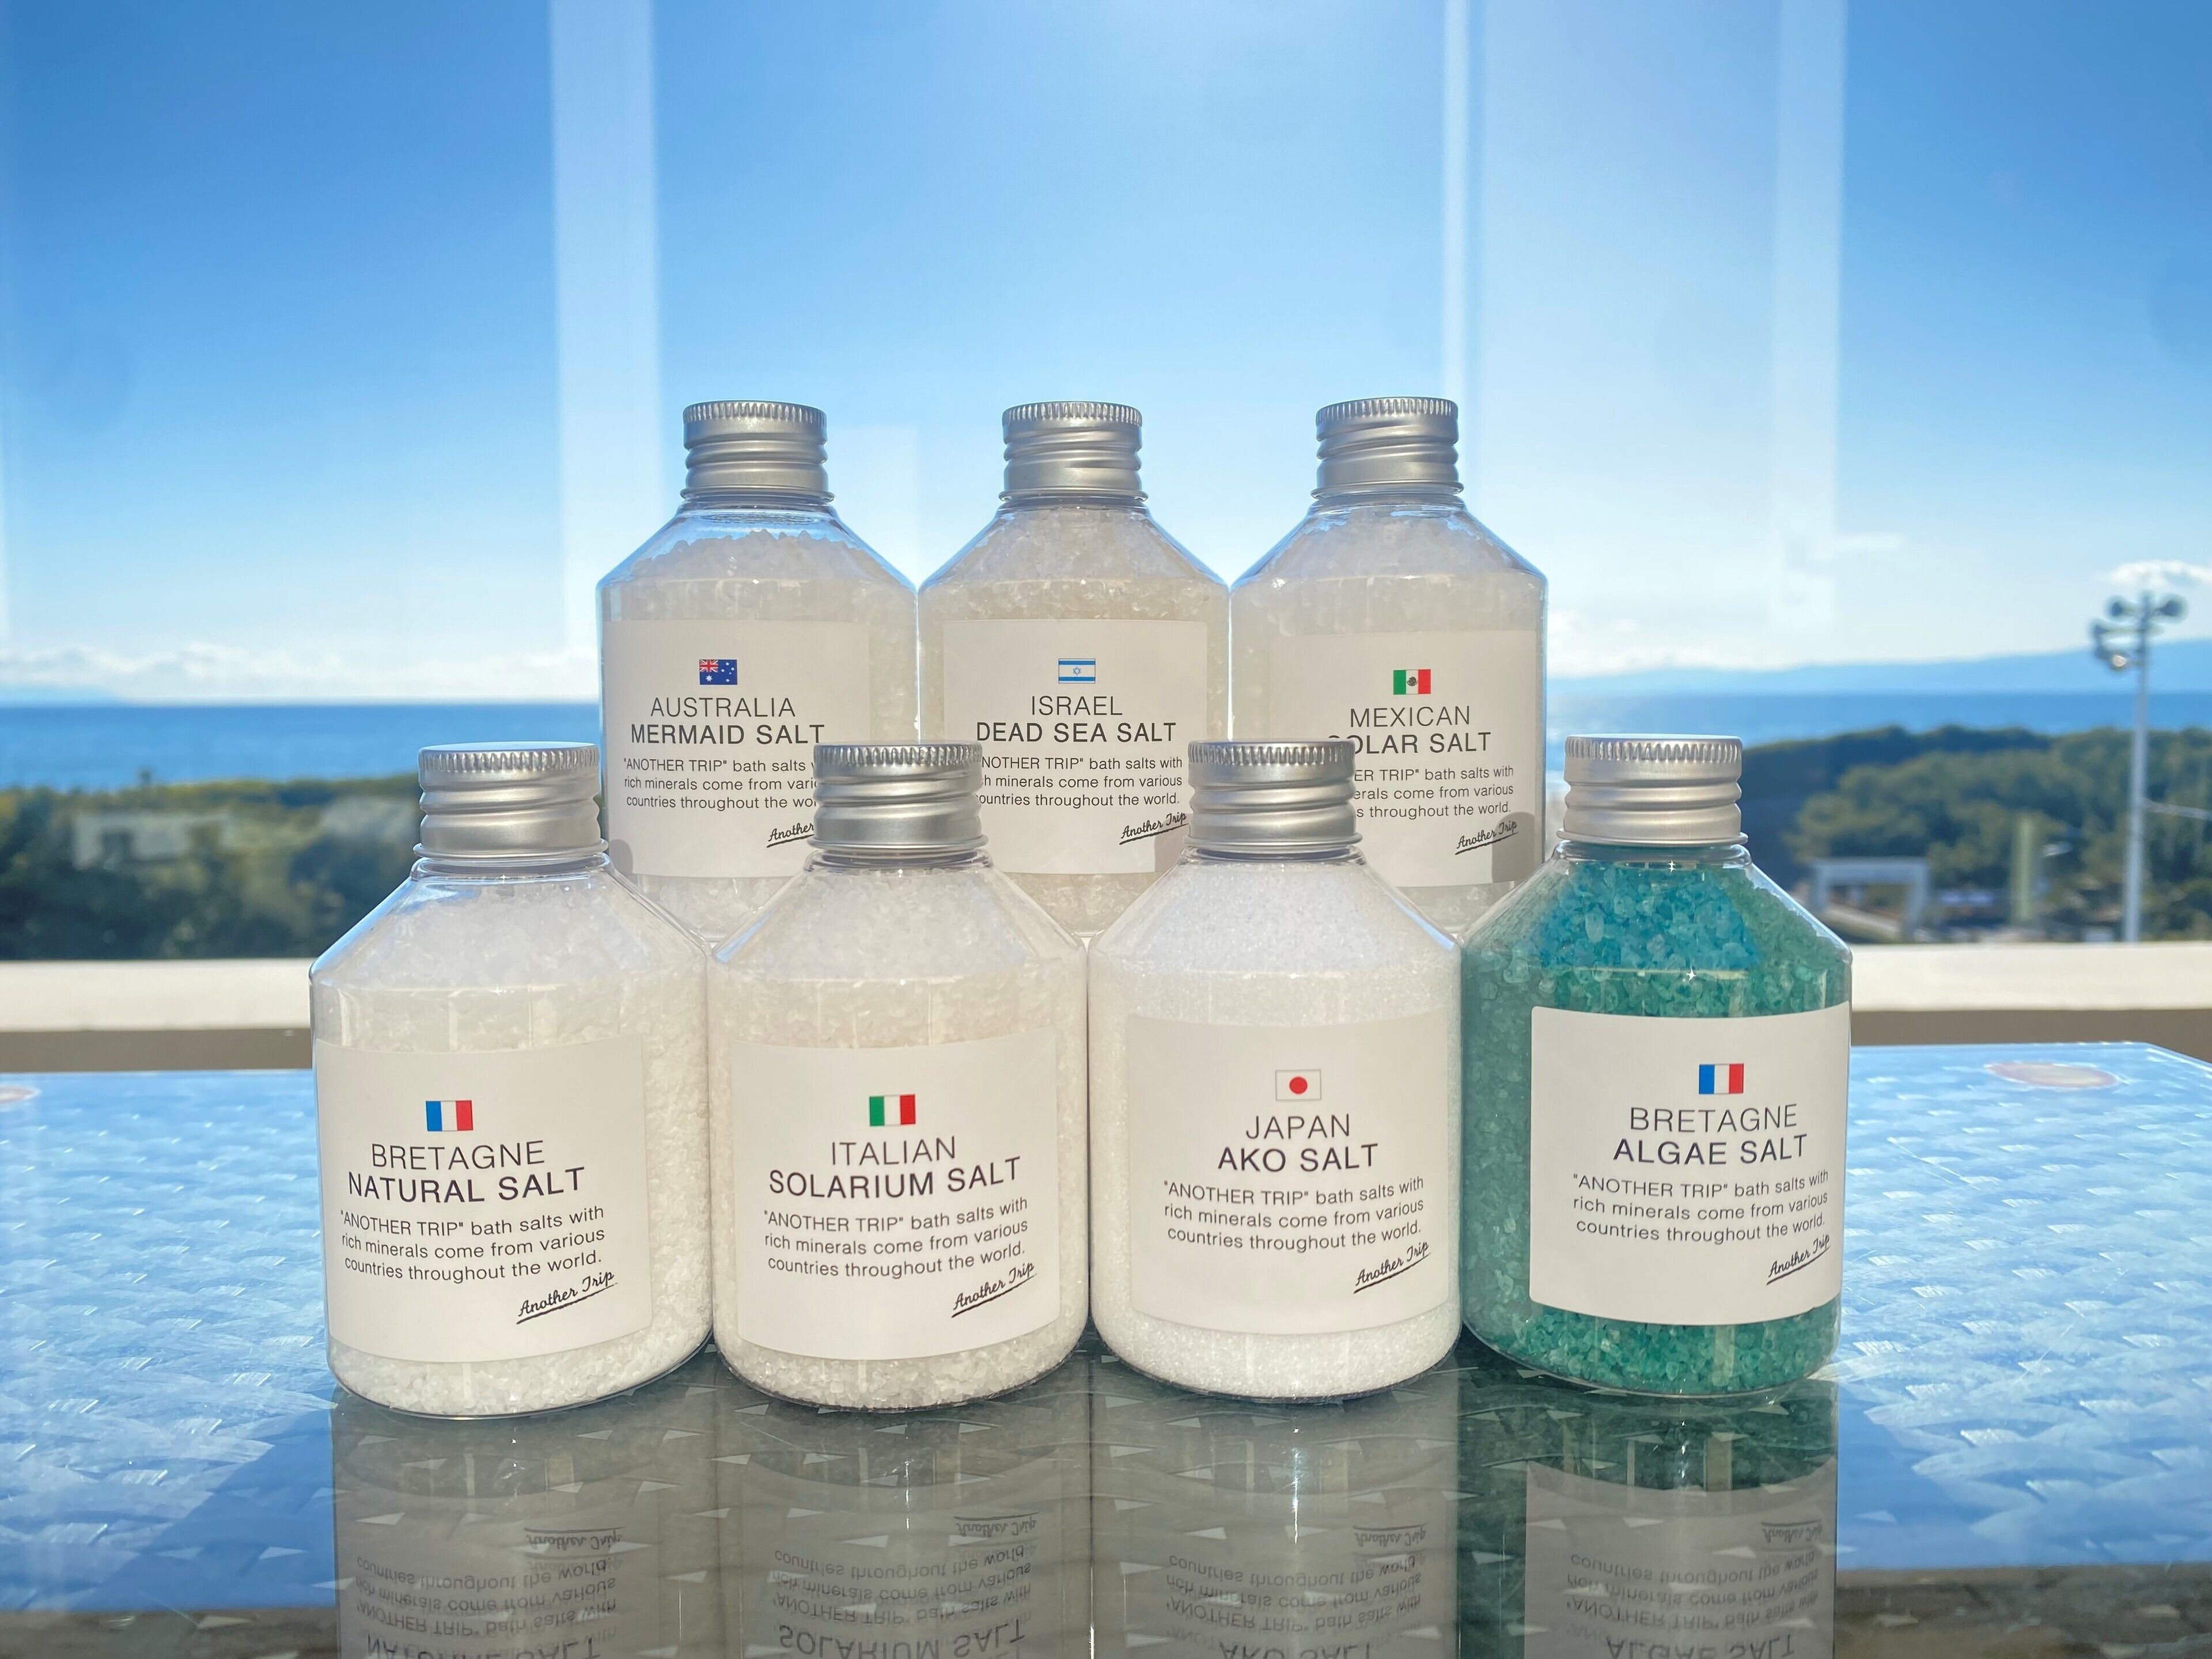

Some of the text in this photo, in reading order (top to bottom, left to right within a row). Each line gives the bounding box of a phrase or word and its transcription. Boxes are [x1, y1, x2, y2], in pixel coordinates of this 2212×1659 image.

[651, 697, 796, 717] AUSTRALIA
[1032, 696, 1123, 715] ISRAEL
[1350, 706, 1469, 728] MEXICAN
[631, 724, 825, 744] MERMAID SALT
[977, 722, 1176, 743] DEAD SEA SALT
[1328, 732, 1491, 754] OLAR SALT
[624, 758, 684, 771] "ANOTHER
[689, 760, 727, 771] TRIP"
[733, 760, 766, 772] bath
[772, 760, 805, 771] salts
[982, 756, 1182, 770] NOTHER TRIP" bath salts with
[1380, 769, 1419, 781] TRIP"
[1425, 768, 1455, 780] bath
[1460, 767, 1489, 779] salts
[1493, 766, 1513, 777] with
[624, 777, 817, 790] rich minerals come from vari
[996, 775, 1053, 787] minerals
[1059, 778, 1099, 787] come
[1104, 776, 1134, 787] from
[1139, 775, 1182, 787] various
[1353, 784, 1513, 800] erals come from various
[627, 796, 676, 808] countries
[680, 797, 759, 811] throughout
[764, 797, 787, 808] the
[976, 793, 1180, 809] ountries throughout the world.
[1369, 805, 1449, 820] throughout
[1453, 804, 1474, 816] the
[1478, 801, 1510, 814] world.
[768, 823, 814, 842] Another
[1120, 812, 1187, 839] Another Trip
[1456, 820, 1517, 849] Another Trip
[1246, 1113, 1350, 1140] JAPAN
[1630, 1104, 1797, 1132] BRETAGNE
[372, 1140, 544, 1170] BRETAGNE
[831, 1135, 955, 1166] ITALIAN
[1218, 1143, 1378, 1172] AKO SALT
[1613, 1134, 1807, 1165] ALGAE SALT
[349, 1166, 585, 1203] NATURAL SALT
[769, 1156, 1020, 1199] SOLARIUM SALT
[1164, 1176, 1423, 1206] "ANOTHER TRIP" bath salts with
[1573, 1169, 1828, 1199] "ANOTHER TRIP" bath salts with
[764, 1197, 1027, 1232] "ANOTHER TRIP" bath salts with
[1165, 1199, 1423, 1228] rich minerals come from various
[1573, 1192, 1827, 1220] rich minerals come from various
[340, 1206, 604, 1236] "ANOTHER TRIP" bath salts with
[1577, 1212, 1824, 1245] countries throughout the world.
[342, 1229, 605, 1259] rich minerals come from various
[766, 1220, 1028, 1255] rich minerals come from various
[1168, 1220, 1421, 1253] countries throughout the world.
[345, 1250, 601, 1284] countries throughout the world.
[768, 1241, 1025, 1279] countries throughout the world.
[1355, 1241, 1429, 1286] Another Trip
[1768, 1233, 1830, 1278] Another Trip
[517, 1271, 615, 1317] Another Trip
[953, 1262, 1035, 1310] Another Trip
